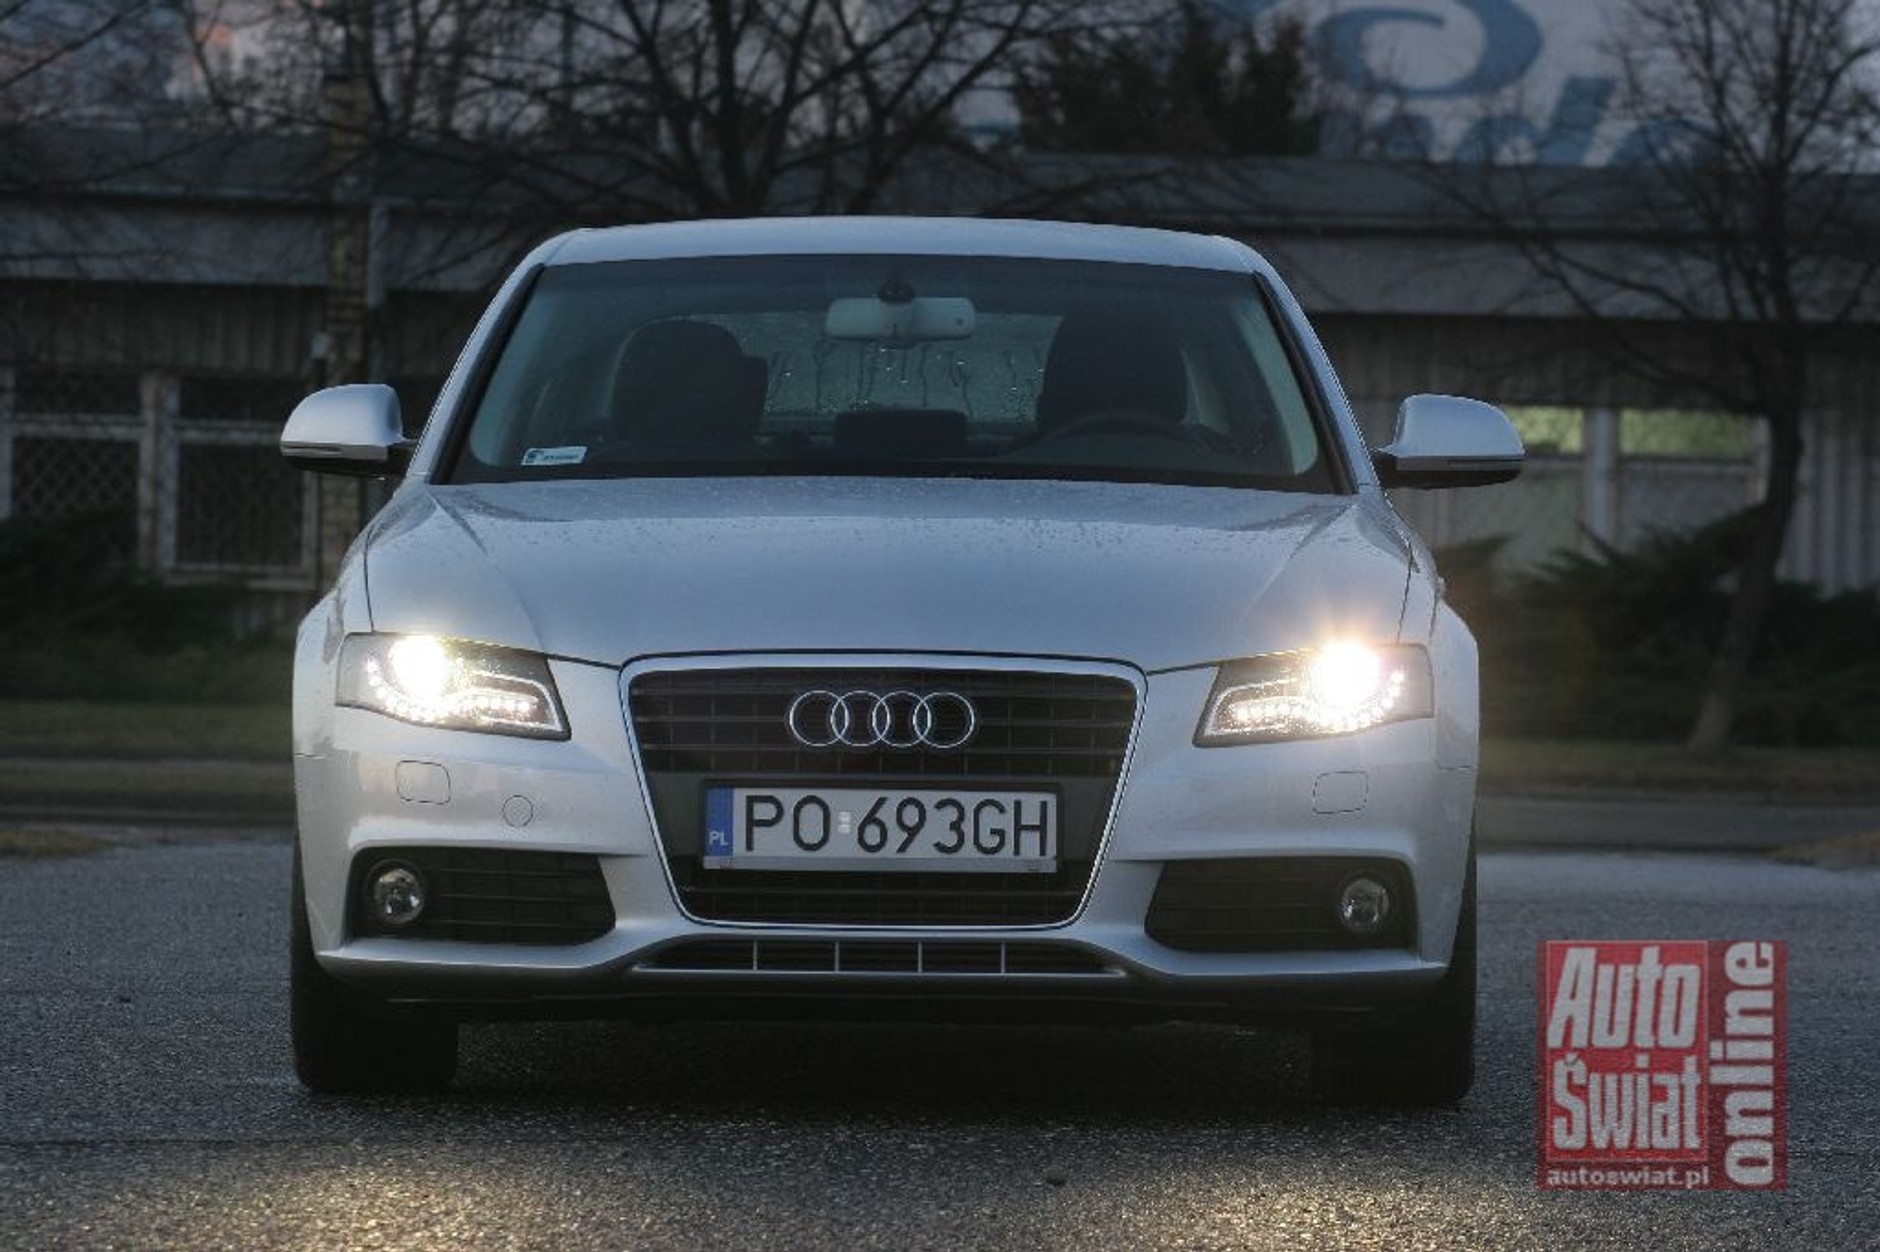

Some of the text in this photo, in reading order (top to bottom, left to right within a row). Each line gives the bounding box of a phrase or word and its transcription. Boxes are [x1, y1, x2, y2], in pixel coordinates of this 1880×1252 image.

[708, 830, 729, 846] PL
[745, 795, 1048, 856] PO 693GH
